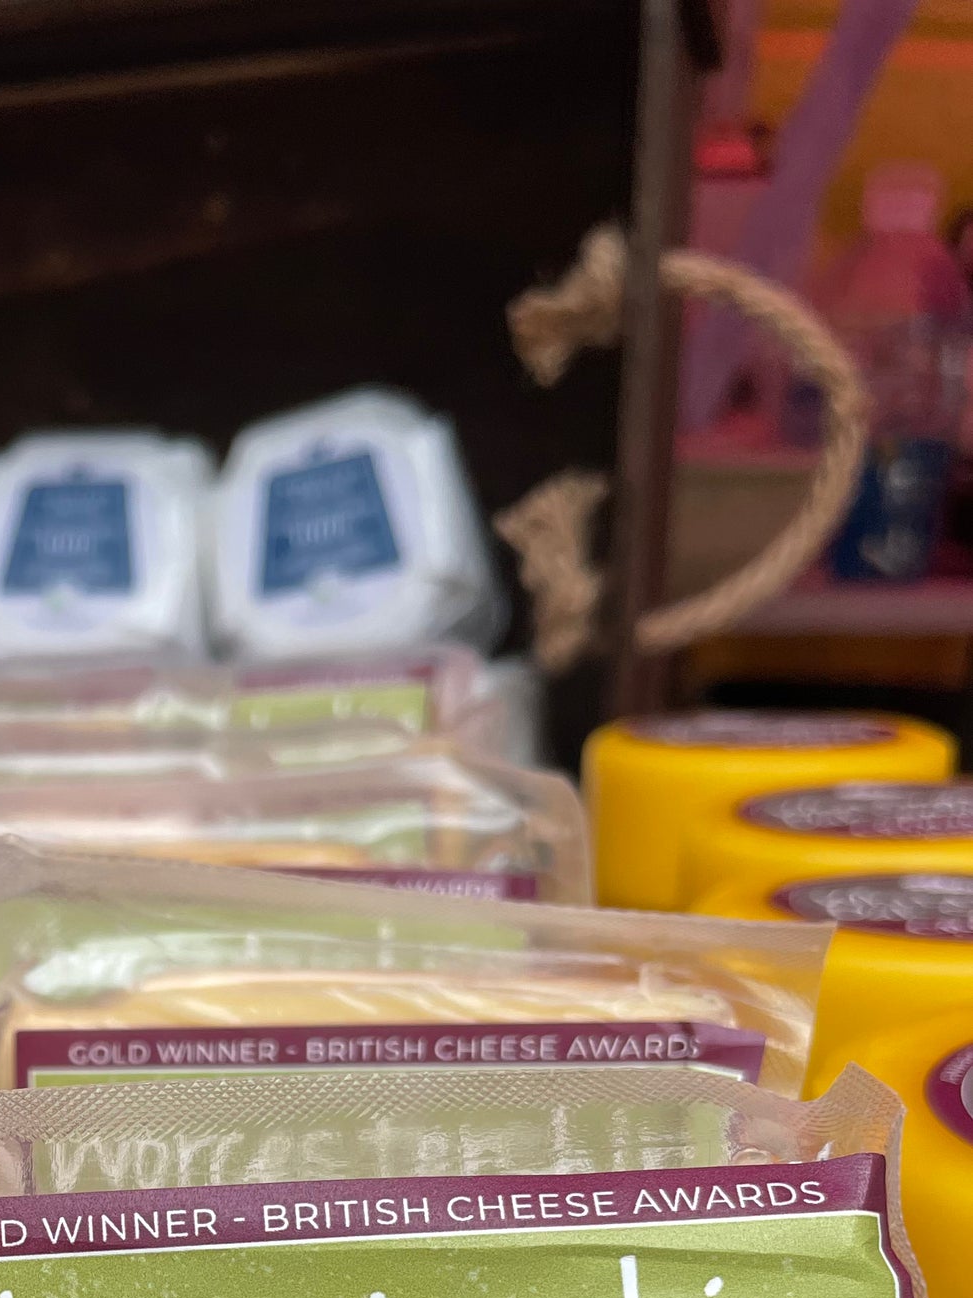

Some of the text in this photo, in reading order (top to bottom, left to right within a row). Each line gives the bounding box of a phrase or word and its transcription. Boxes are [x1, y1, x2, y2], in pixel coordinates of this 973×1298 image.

[68, 1040, 149, 1066] GOLD
[156, 1037, 278, 1065] WINNER
[305, 1036, 425, 1063] BRITISH
[433, 1034, 558, 1062] CHEESE
[566, 1033, 702, 1061] AWARDS
[41, 1207, 218, 1245] WINNER
[263, 1195, 430, 1232] BRITISH
[446, 1190, 618, 1222] CHEESE
[633, 1179, 826, 1216] AWARDS
